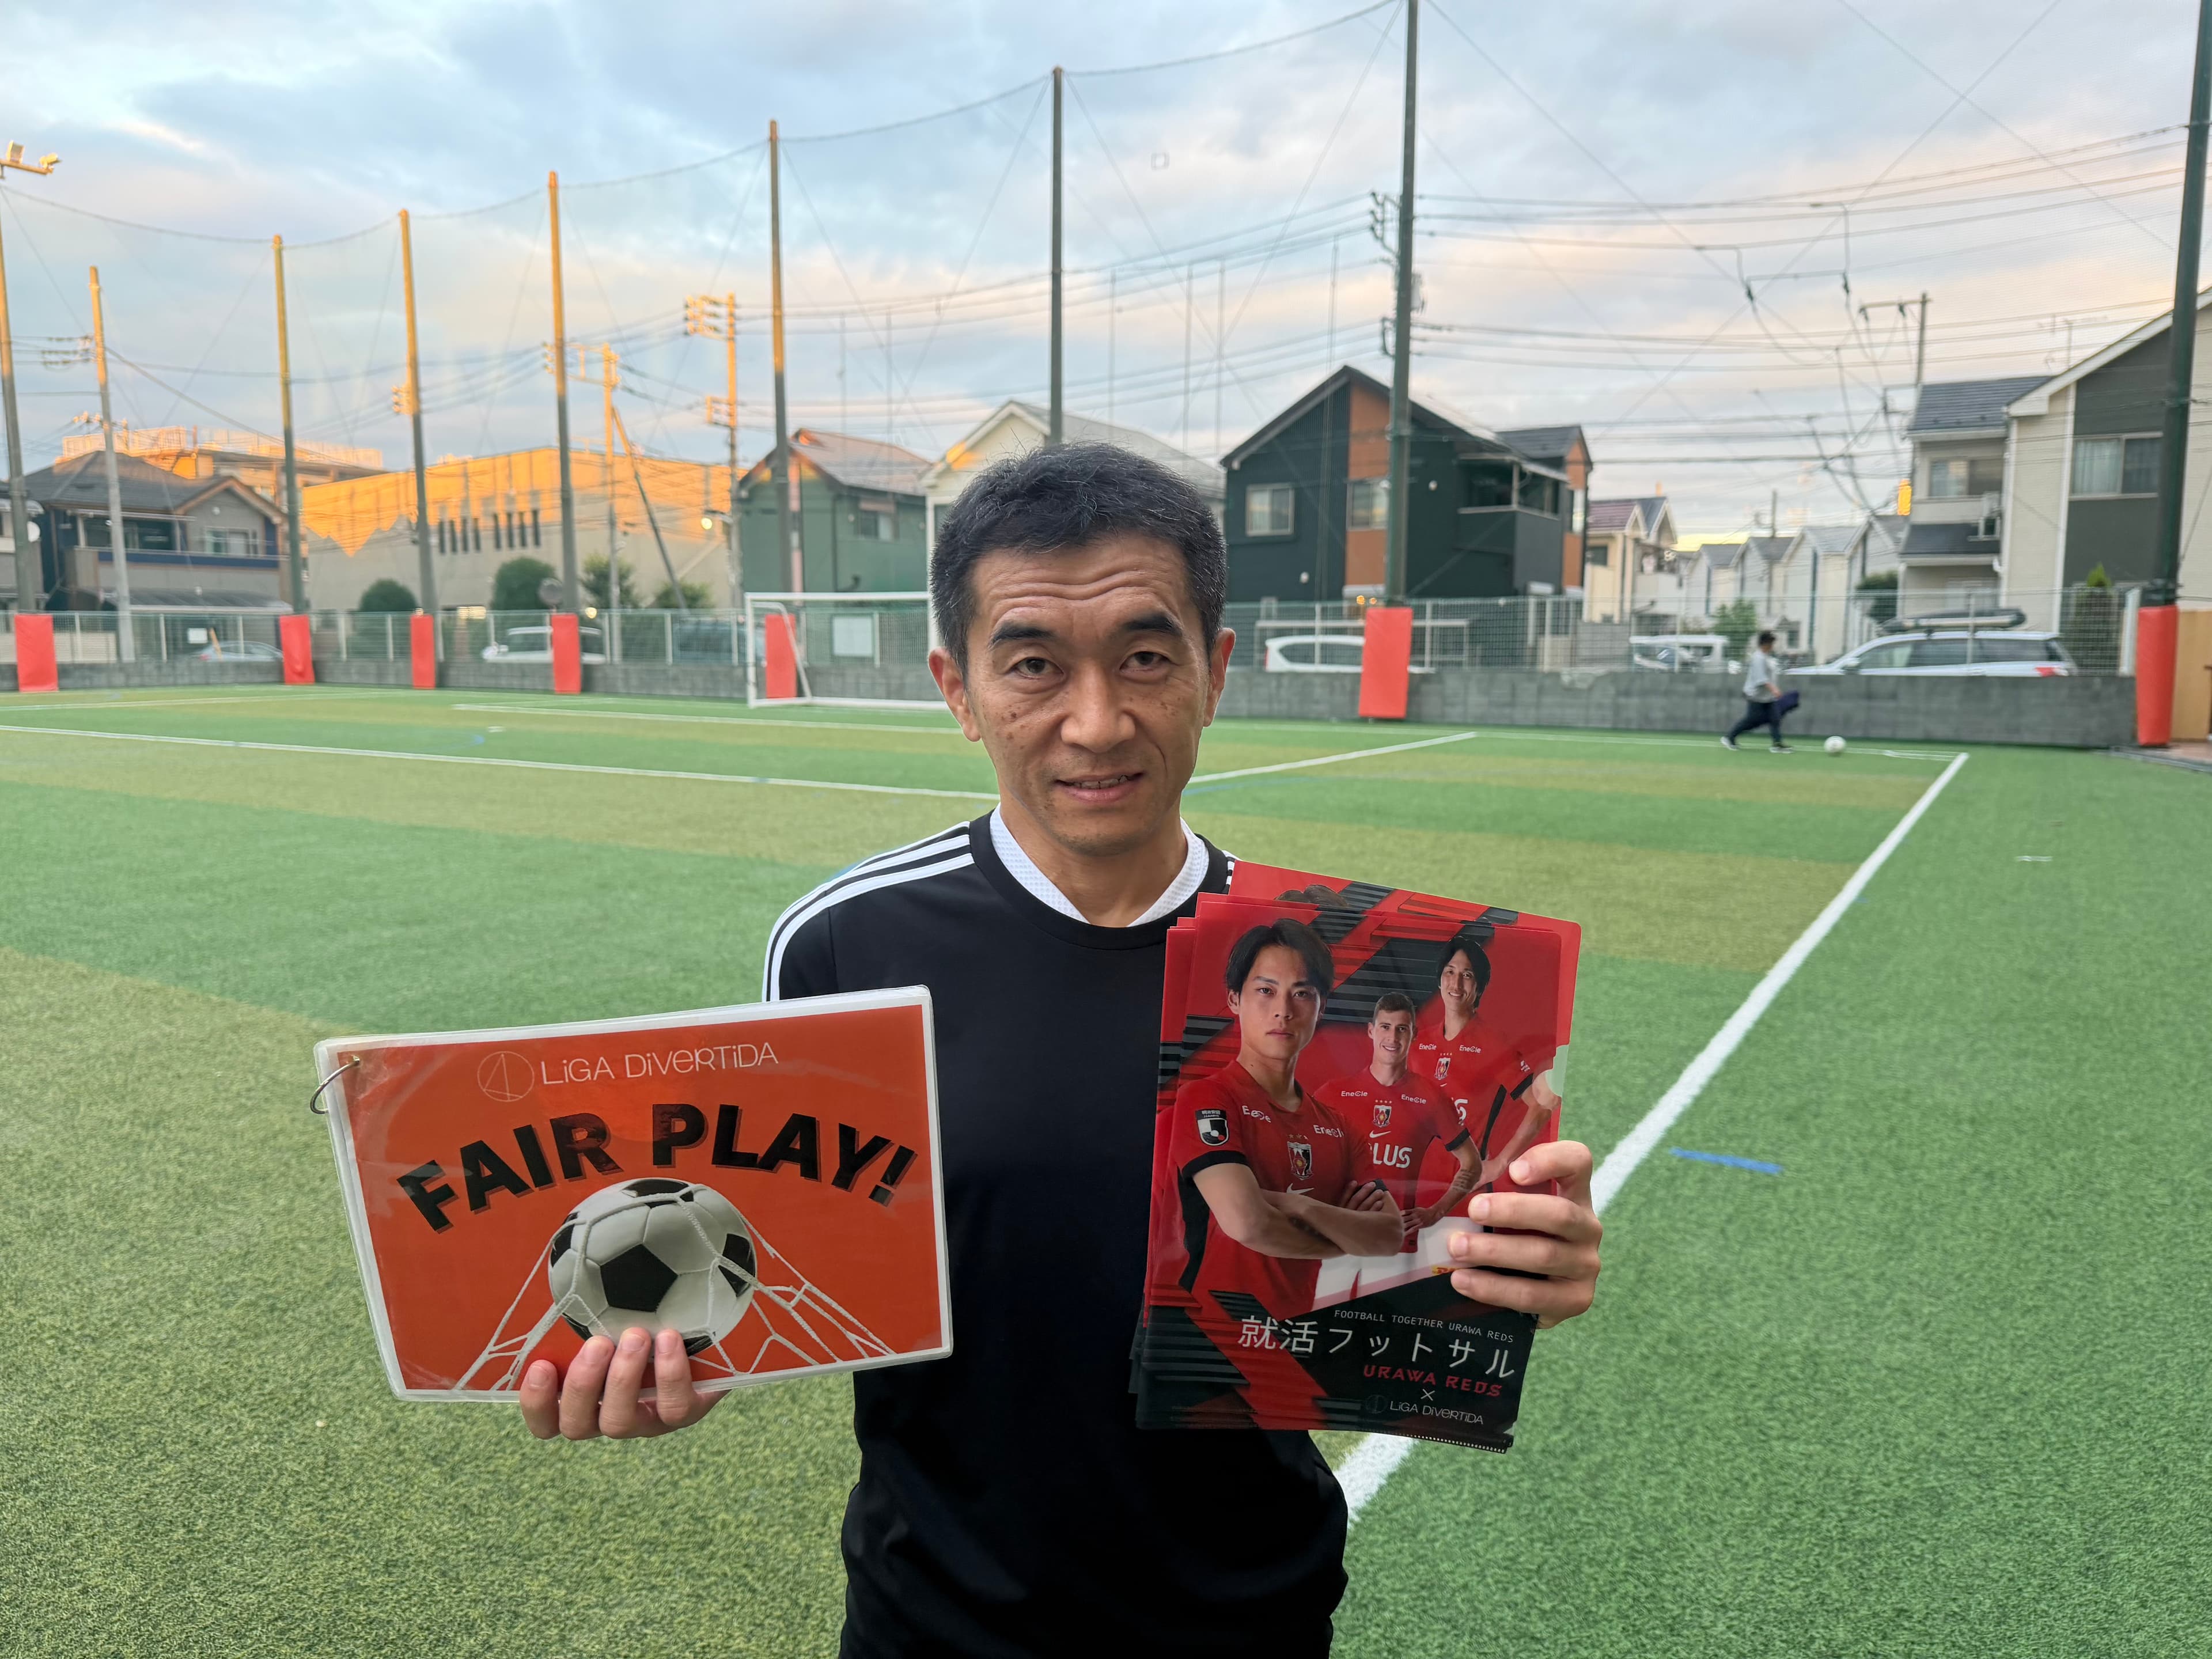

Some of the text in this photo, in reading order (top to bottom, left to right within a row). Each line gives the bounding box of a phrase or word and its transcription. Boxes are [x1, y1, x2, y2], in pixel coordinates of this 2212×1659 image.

[396, 1103, 918, 1234] FAIR PLAY!
[1368, 1142, 1413, 1168] LUS
[1334, 1309, 1514, 1343] FOOTBALL TOGETHER URAWA REDS
[1237, 1315, 1515, 1378] 就活フットサル
[1363, 1365, 1503, 1397] URAWA REDS
